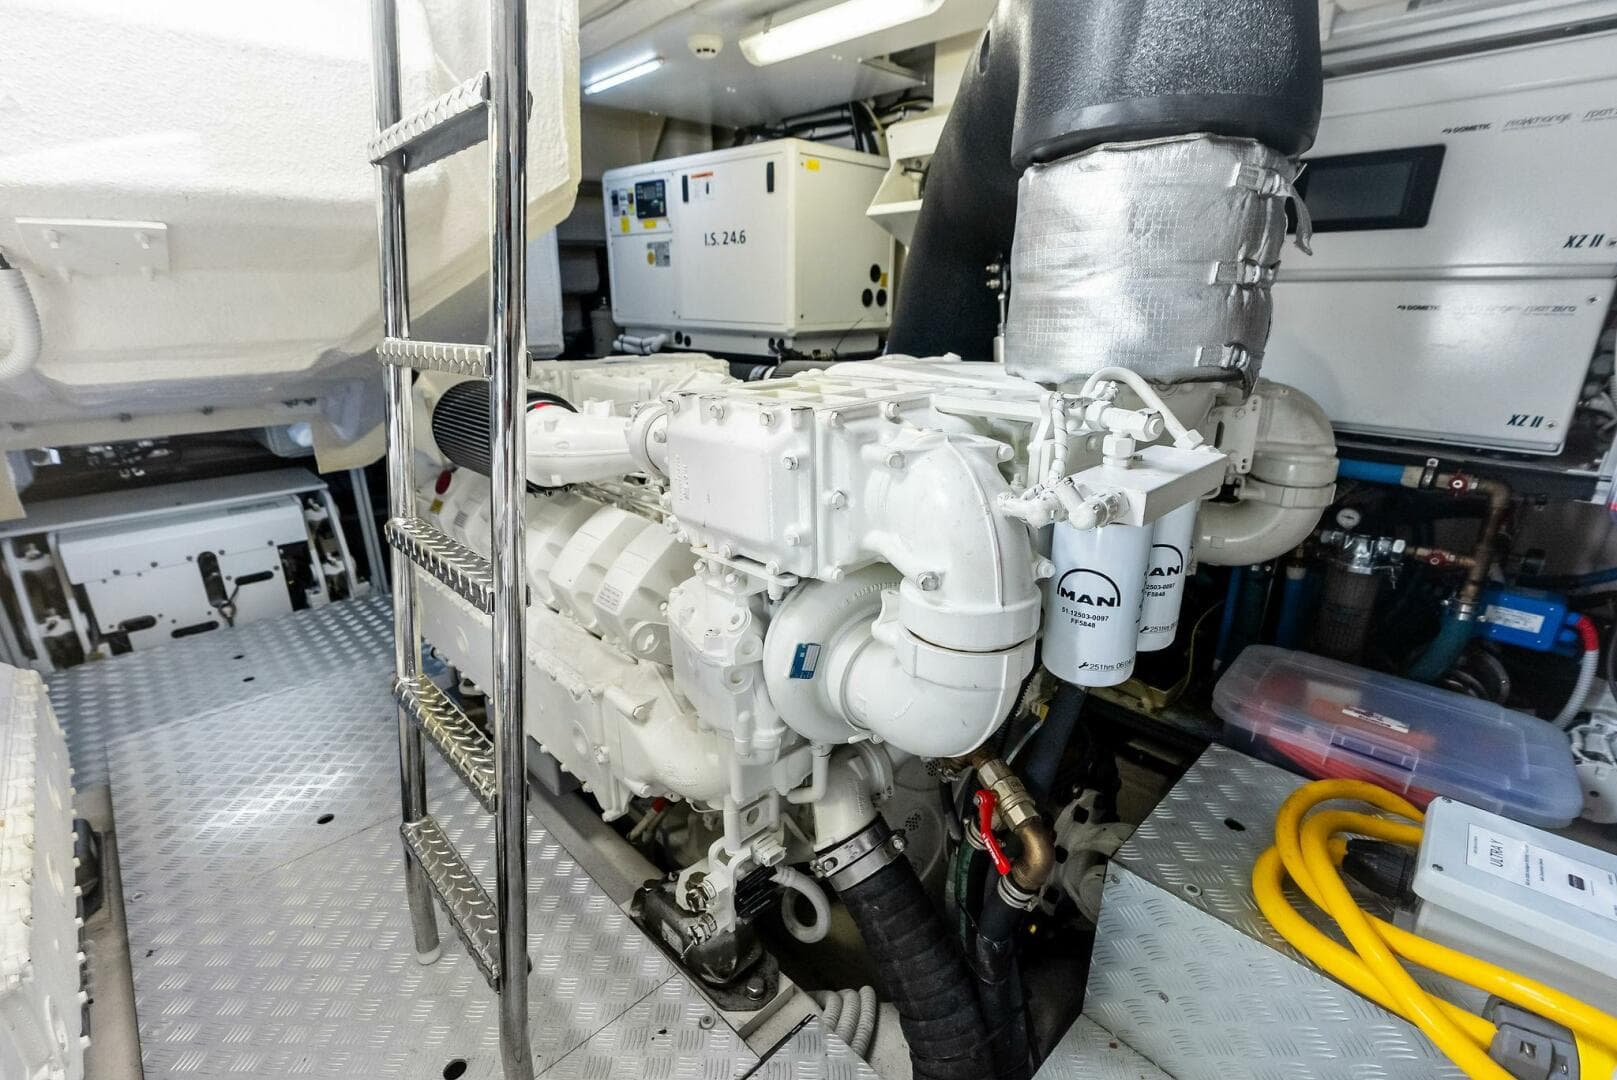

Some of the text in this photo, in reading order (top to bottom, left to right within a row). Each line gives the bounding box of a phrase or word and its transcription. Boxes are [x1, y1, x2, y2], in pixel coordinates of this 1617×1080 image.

[704, 230, 746, 247] I.S. 24.6
[1562, 233, 1588, 249] XZ
[1506, 414, 1530, 427] XZ
[1148, 566, 1180, 576] AN
[1061, 587, 1115, 607] MAN
[1061, 606, 1110, 622] 51.12503-0097
[1070, 618, 1096, 629] FF5848
[1489, 845, 1504, 868] ULTRA
